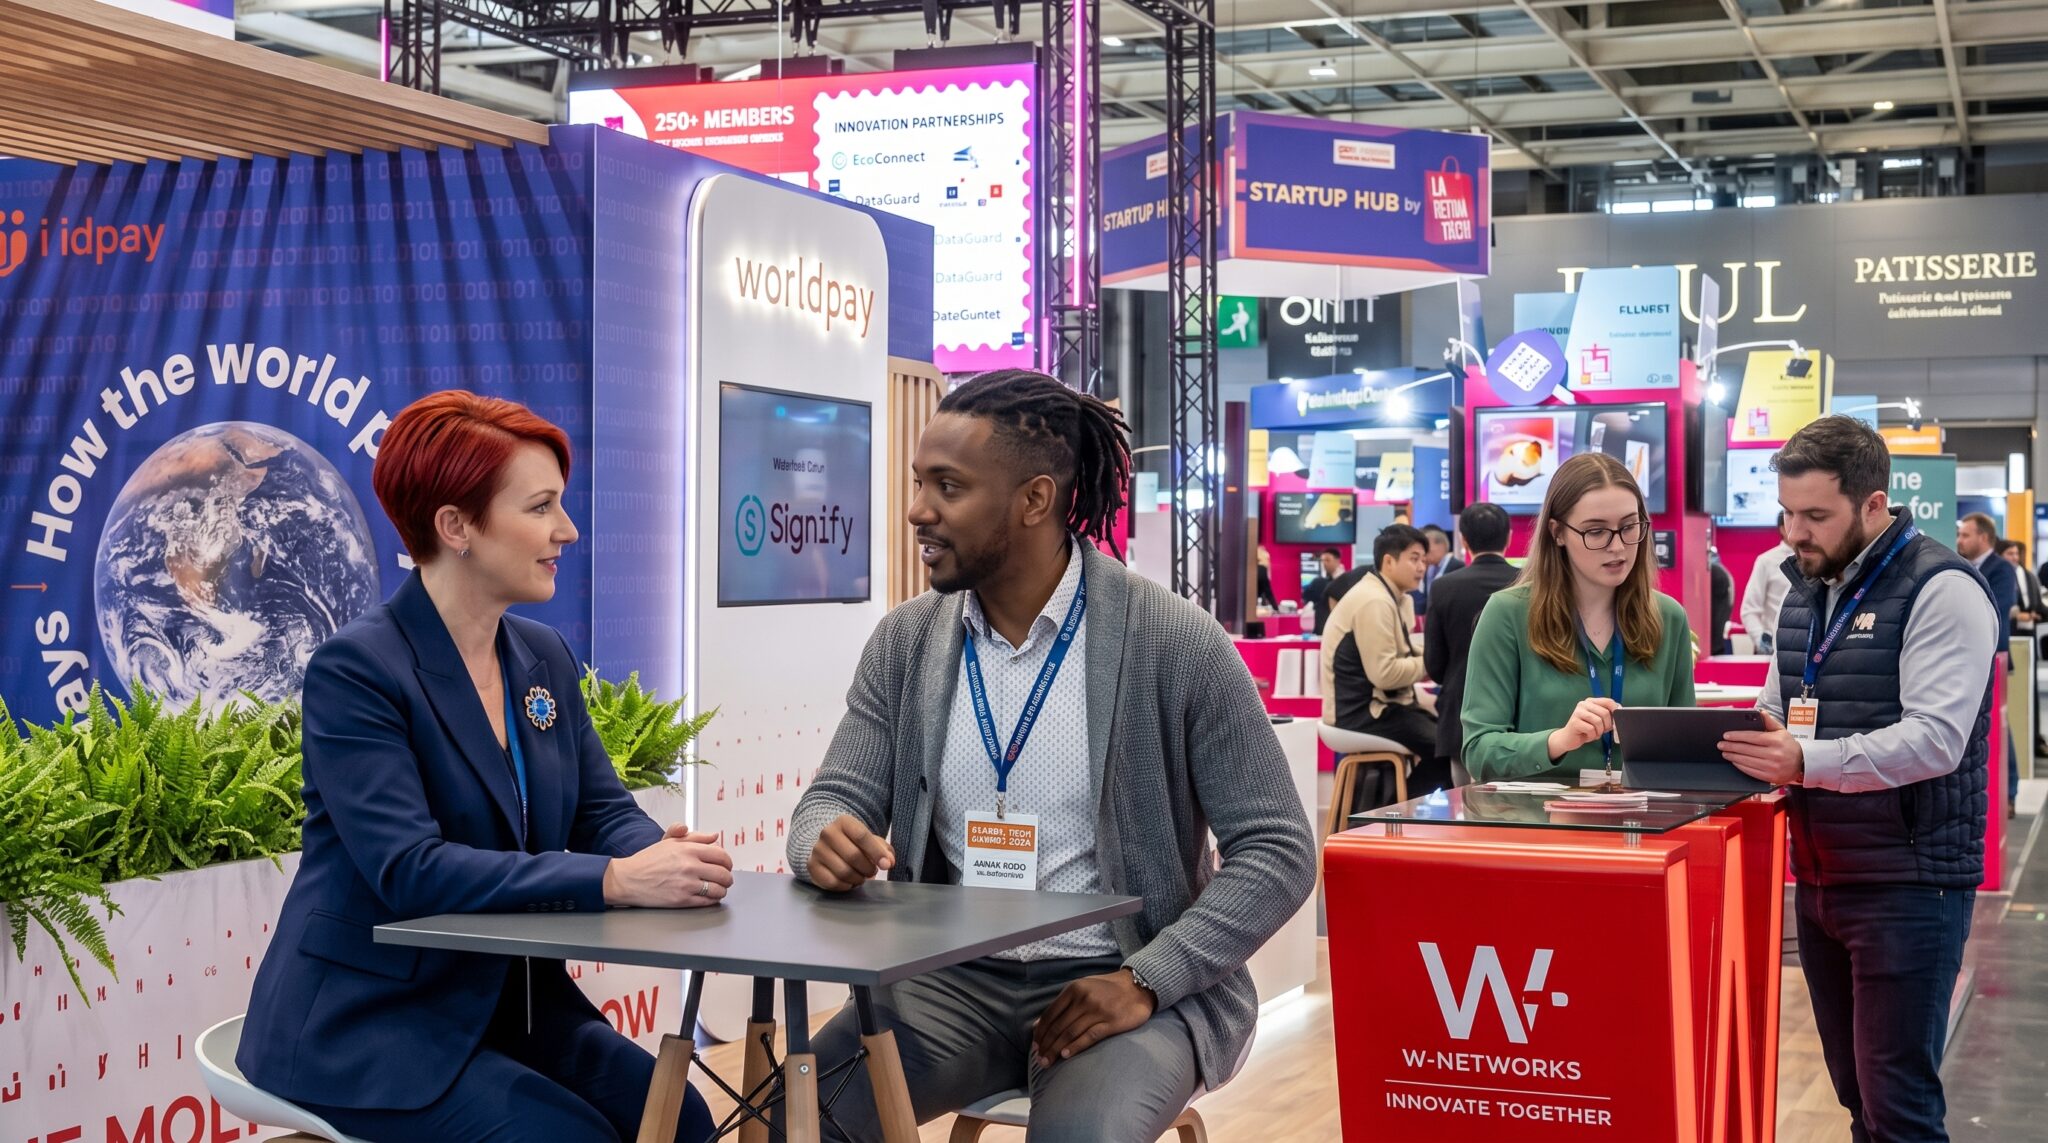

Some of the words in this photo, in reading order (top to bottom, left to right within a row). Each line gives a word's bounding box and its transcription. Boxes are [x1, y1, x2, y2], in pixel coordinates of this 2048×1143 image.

[655, 112, 699, 132] 250+
[704, 105, 795, 129] MEMBERS
[835, 118, 908, 133] INNOVATION
[912, 112, 1004, 129] PARTNERSHIPS
[853, 152, 925, 166] EcoConnect
[855, 193, 920, 207] DataGuard
[1250, 181, 1348, 208] STARTUP
[1354, 189, 1400, 212] HUB
[1404, 197, 1421, 215] by
[1431, 176, 1447, 197] LA
[1103, 203, 1154, 232] STARTUP
[61, 216, 165, 265] idpay
[935, 232, 1002, 245] DataGuard
[936, 270, 1002, 284] DataGuard
[1854, 251, 2038, 283] PATISSERIE
[735, 257, 874, 339] worldpay
[26, 418, 108, 562] How
[101, 352, 196, 430] the
[206, 343, 371, 428] world
[1908, 494, 1944, 520] for
[770, 502, 853, 555] Signify
[35, 610, 91, 731] ays
[1402, 1049, 1582, 1081] W-NETWORKS
[1385, 1092, 1490, 1116] INNOVATE
[1497, 1101, 1612, 1126] TOGETHER
